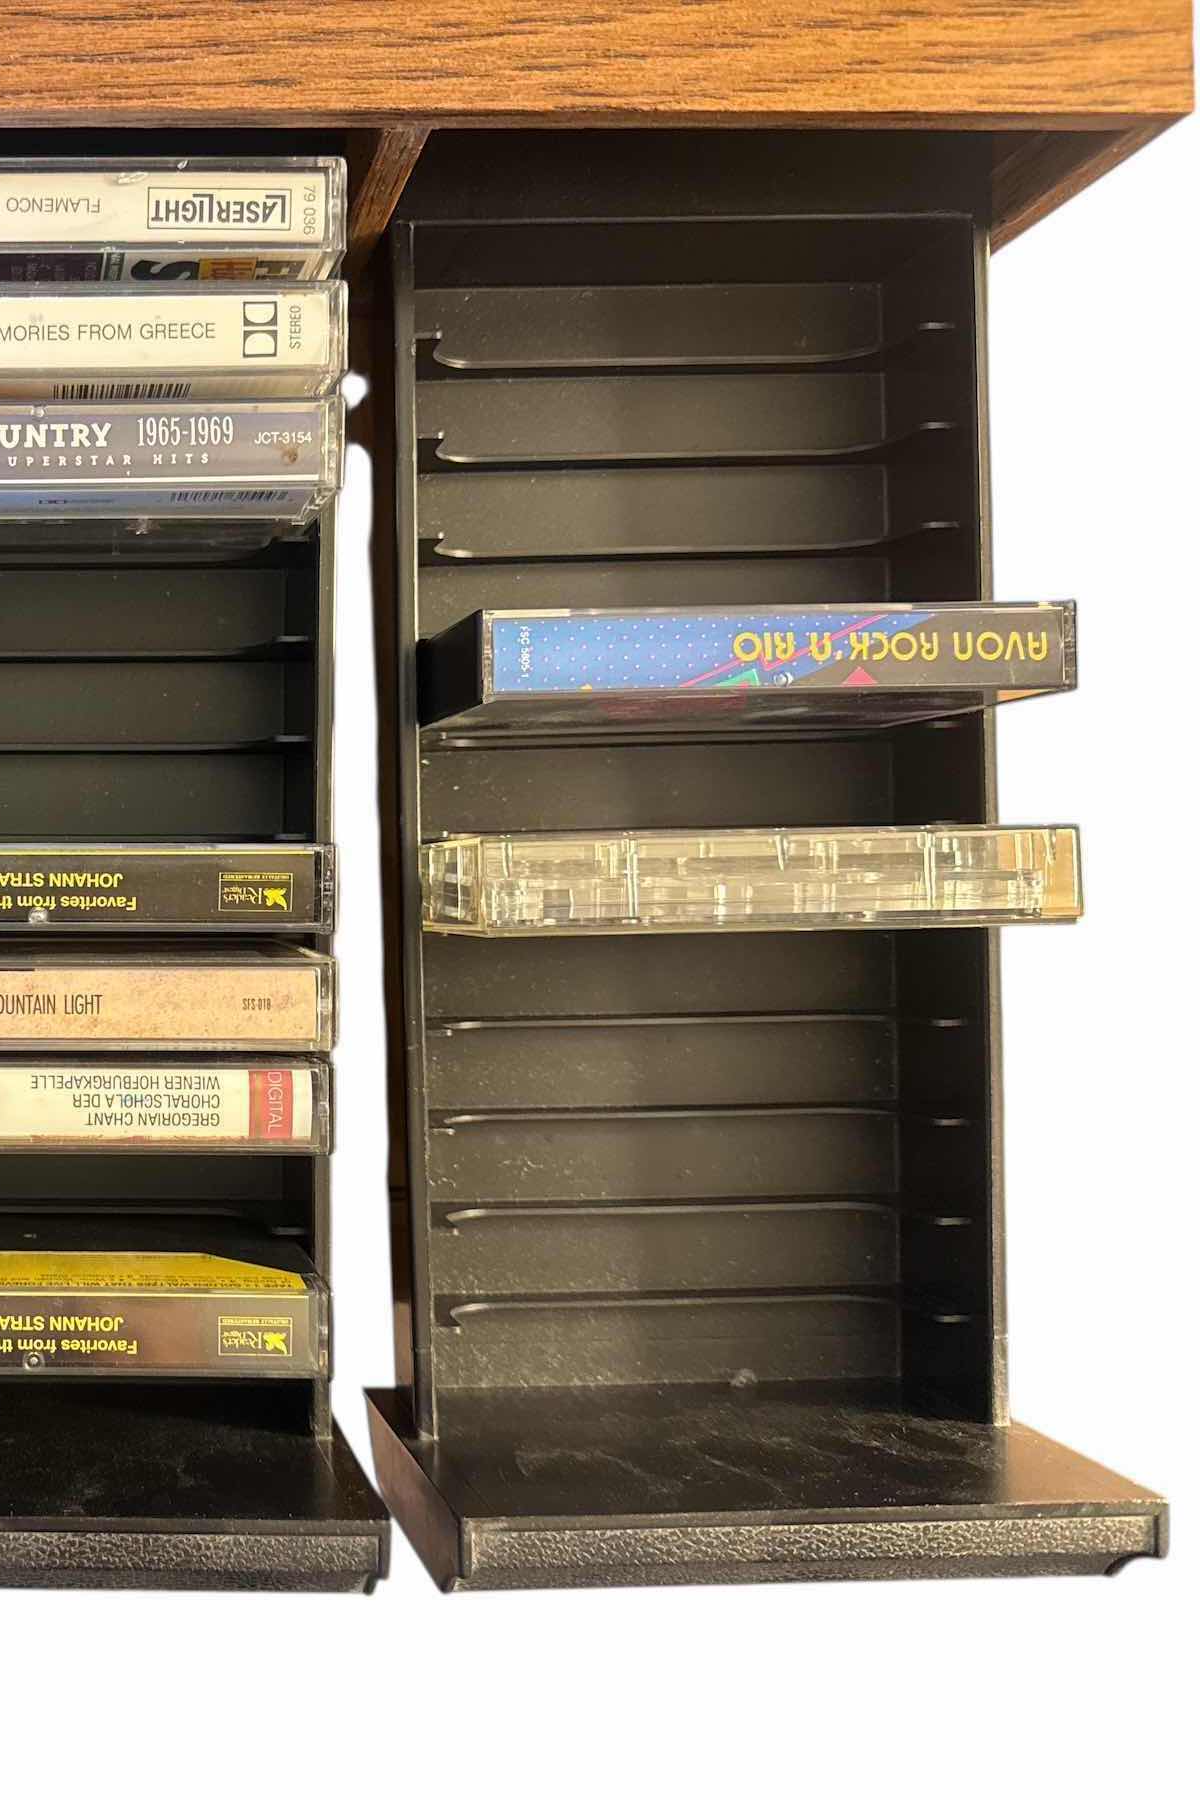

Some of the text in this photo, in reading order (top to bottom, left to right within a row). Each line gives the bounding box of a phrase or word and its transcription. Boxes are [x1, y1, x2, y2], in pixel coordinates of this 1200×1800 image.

[6, 197, 101, 213] FLAMENCO
[303, 184, 316, 235] 79 036
[78, 323, 132, 341] FROM
[139, 322, 217, 340] GREECE
[289, 305, 302, 350] STEREO
[137, 416, 234, 447] 1965-1969
[254, 431, 313, 445] JCT-3154
[153, 453, 209, 465] HITS
[733, 631, 794, 662] RIO
[848, 631, 939, 661] ROCK
[953, 631, 1048, 661] AVON
[49, 872, 123, 888] JOHANN
[17, 895, 57, 910] from
[60, 895, 137, 911] Favorites
[64, 994, 103, 1015] LIGHT
[31, 1075, 220, 1090] WIENER HOFBURGKAPELLE
[72, 1093, 220, 1108] CHORALSCHOLA DER
[267, 1071, 283, 1132] DIGITAL
[85, 1112, 220, 1127] GREGORIAN CHANT
[49, 1315, 124, 1331] JOHANN
[16, 1338, 57, 1354] from
[61, 1339, 137, 1355] Favorites
